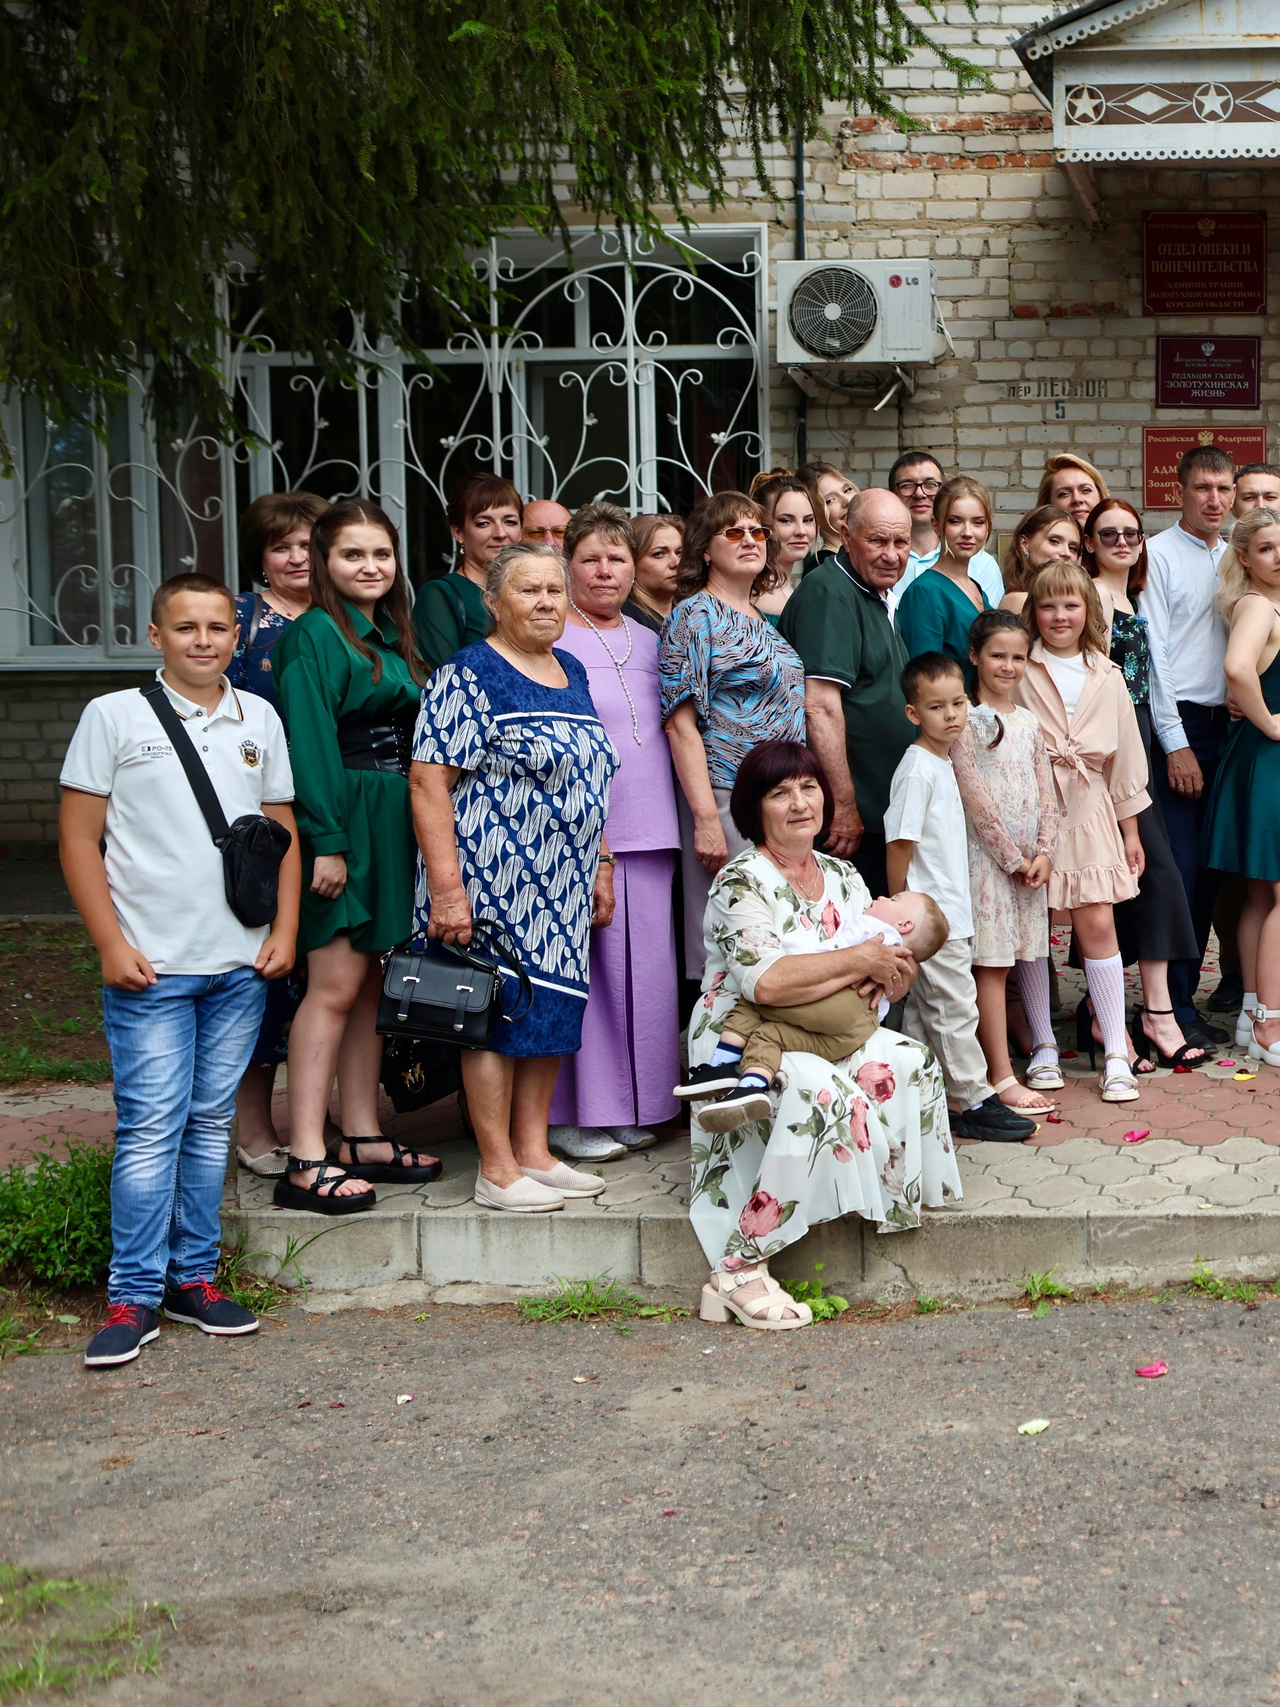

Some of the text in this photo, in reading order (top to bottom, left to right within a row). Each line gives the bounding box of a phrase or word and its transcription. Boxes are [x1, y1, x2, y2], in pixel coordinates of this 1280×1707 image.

[1158, 243, 1251, 256] ОТДЕЛ ОПЕКИ И
[1151, 260, 1259, 273] ПОПЕЧИТЕЛЬСТВА
[906, 277, 919, 285] LG
[1167, 281, 1244, 289] АДМИНИСТРАЦИИ
[1227, 290, 1262, 298] РАЙОНА
[1055, 399, 1066, 419] 5
[1147, 435, 1262, 443] Российская Федерация
